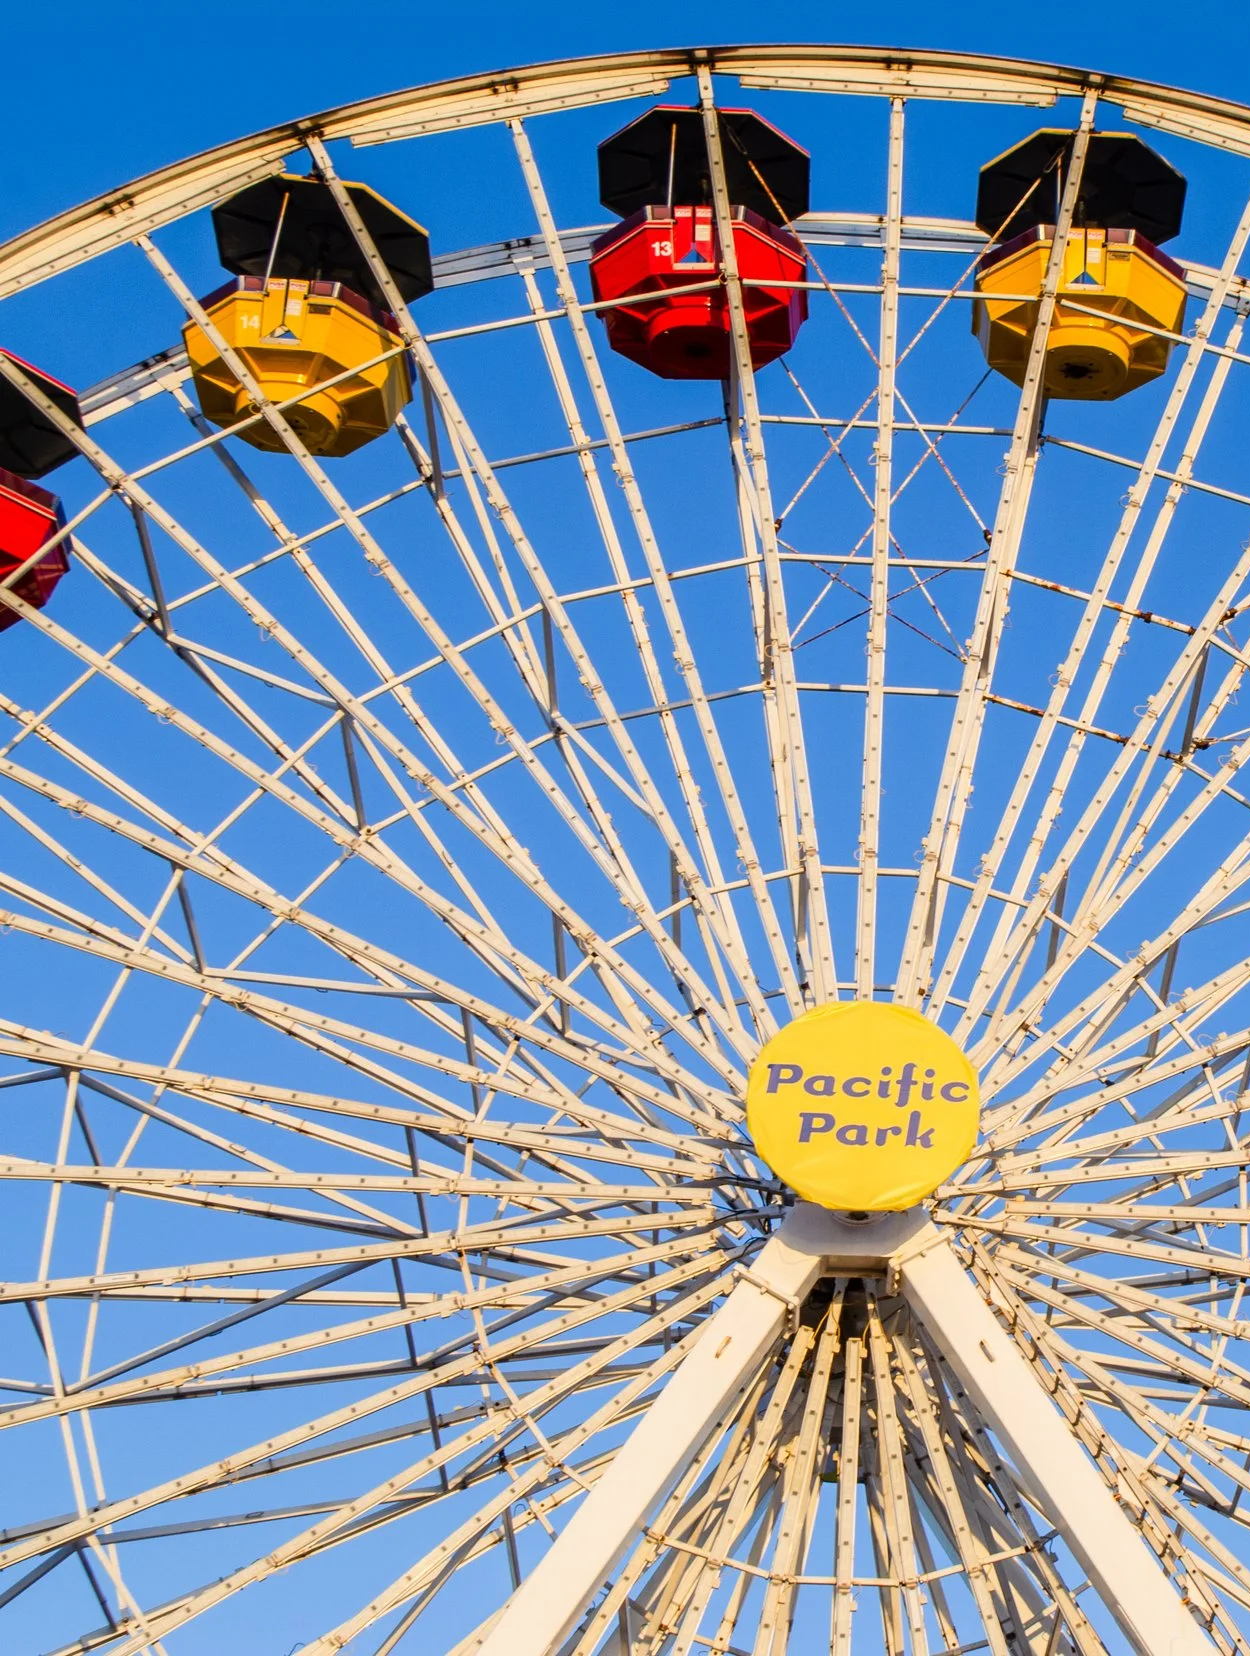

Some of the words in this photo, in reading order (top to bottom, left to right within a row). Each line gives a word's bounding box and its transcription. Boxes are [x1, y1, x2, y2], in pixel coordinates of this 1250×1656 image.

[651, 241, 672, 257] 13
[239, 315, 260, 329] 14
[766, 1062, 971, 1107] Pacific
[798, 1110, 935, 1148] Park
